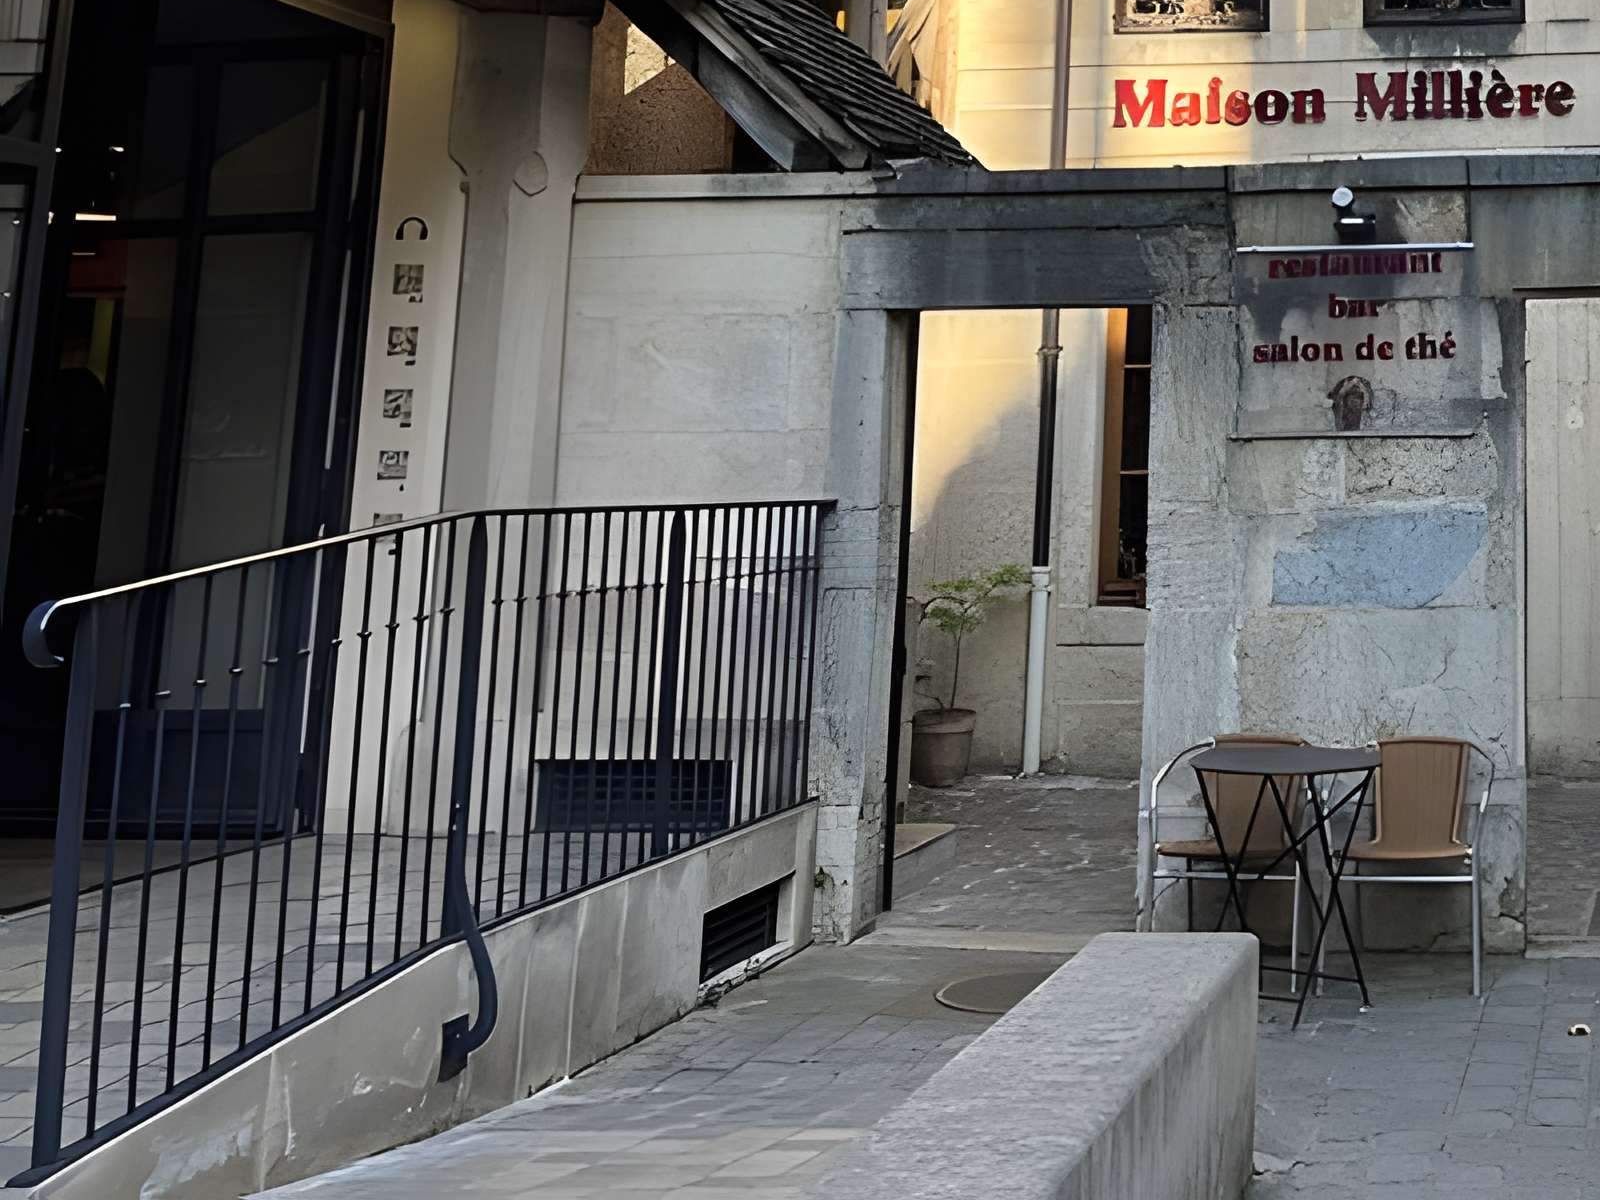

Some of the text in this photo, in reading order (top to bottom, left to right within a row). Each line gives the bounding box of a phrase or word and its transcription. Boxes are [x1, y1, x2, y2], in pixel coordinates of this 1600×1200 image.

[1112, 69, 1577, 128] Maison Millière
[1253, 331, 1457, 362] salon de thé
